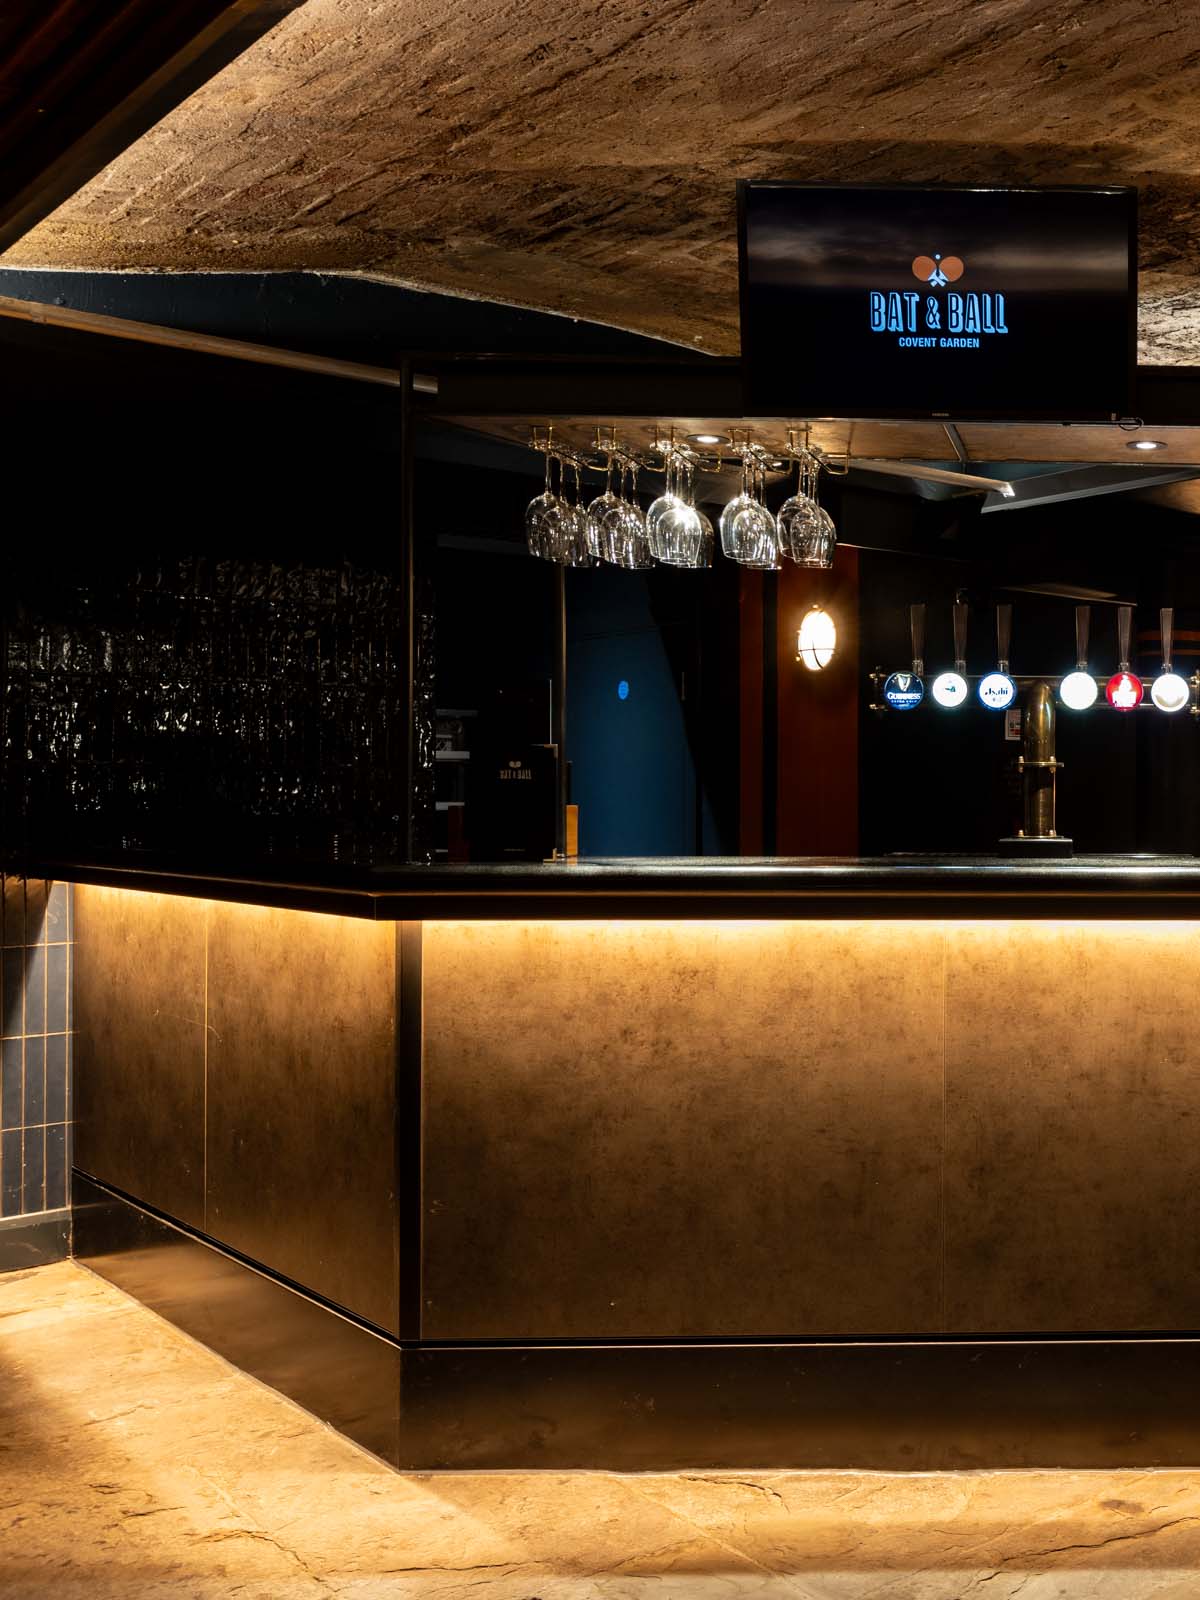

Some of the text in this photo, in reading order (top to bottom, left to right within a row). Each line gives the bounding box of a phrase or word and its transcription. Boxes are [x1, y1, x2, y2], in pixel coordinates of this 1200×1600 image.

[870, 291, 1008, 333] BAT & BALL
[898, 337, 980, 348] COVENT GARDEN
